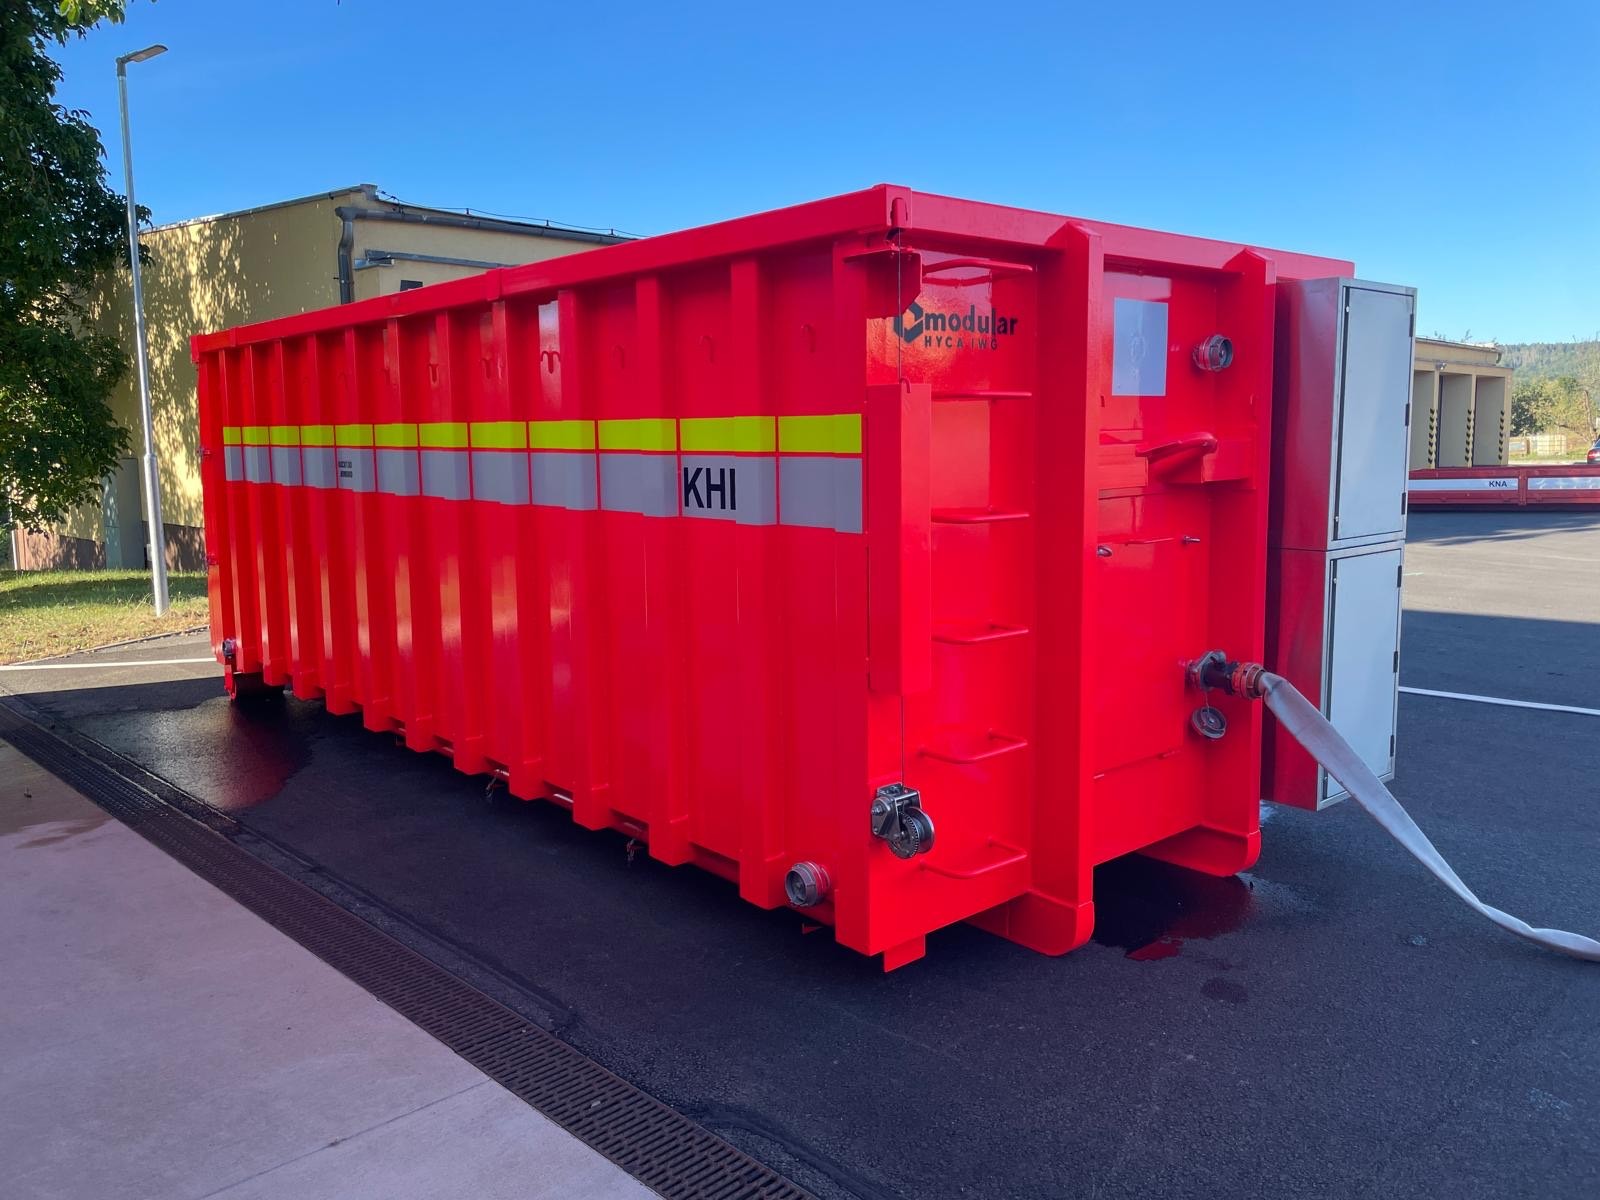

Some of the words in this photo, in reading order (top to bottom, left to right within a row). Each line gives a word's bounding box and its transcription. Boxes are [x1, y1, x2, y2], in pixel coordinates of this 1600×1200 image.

[924, 304, 1018, 336] modular
[683, 467, 737, 510] KHI
[1488, 480, 1508, 488] KNA
